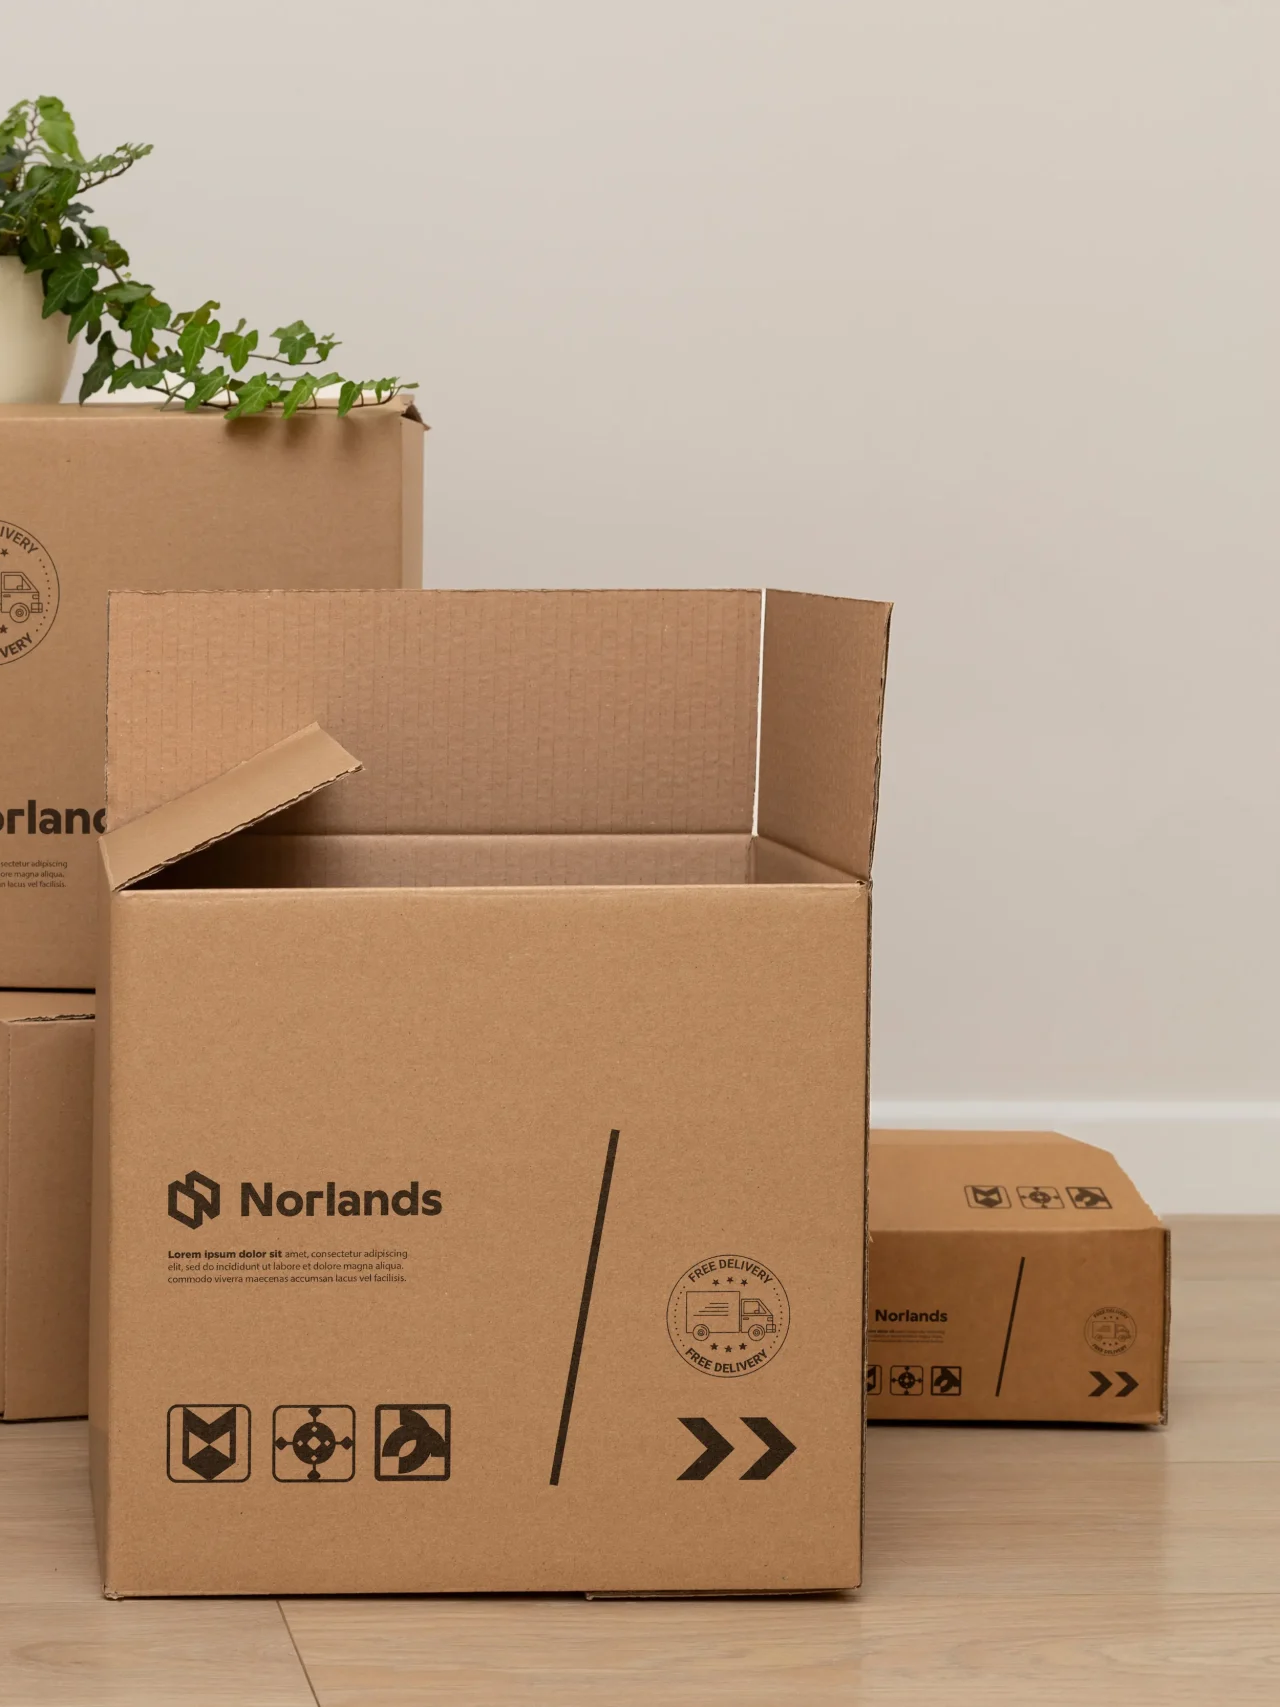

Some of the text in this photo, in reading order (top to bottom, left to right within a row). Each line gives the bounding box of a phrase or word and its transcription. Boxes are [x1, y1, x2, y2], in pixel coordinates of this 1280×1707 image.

[31, 860, 68, 869] adipiscing
[241, 1181, 443, 1217] Norlands
[168, 1249, 408, 1260] Lorem ipsum dolor sit amet, consectetur adipiscing
[168, 1263, 183, 1272] elit,
[186, 1263, 200, 1271] sed
[202, 1263, 215, 1271] do
[216, 1262, 260, 1271] incididunt
[273, 1262, 301, 1270] labore
[313, 1262, 342, 1270] dolore
[343, 1263, 373, 1272] magna
[375, 1262, 404, 1271] aliqua.
[688, 1259, 773, 1284] FREE DELIVERY
[168, 1275, 212, 1284] commodo
[214, 1275, 243, 1283] viverra
[335, 1274, 357, 1282] lacus
[359, 1274, 372, 1282] vel
[374, 1274, 407, 1282] facilisis.
[875, 1309, 948, 1322] Norlands
[685, 1347, 768, 1373] FREE DELIVERY
